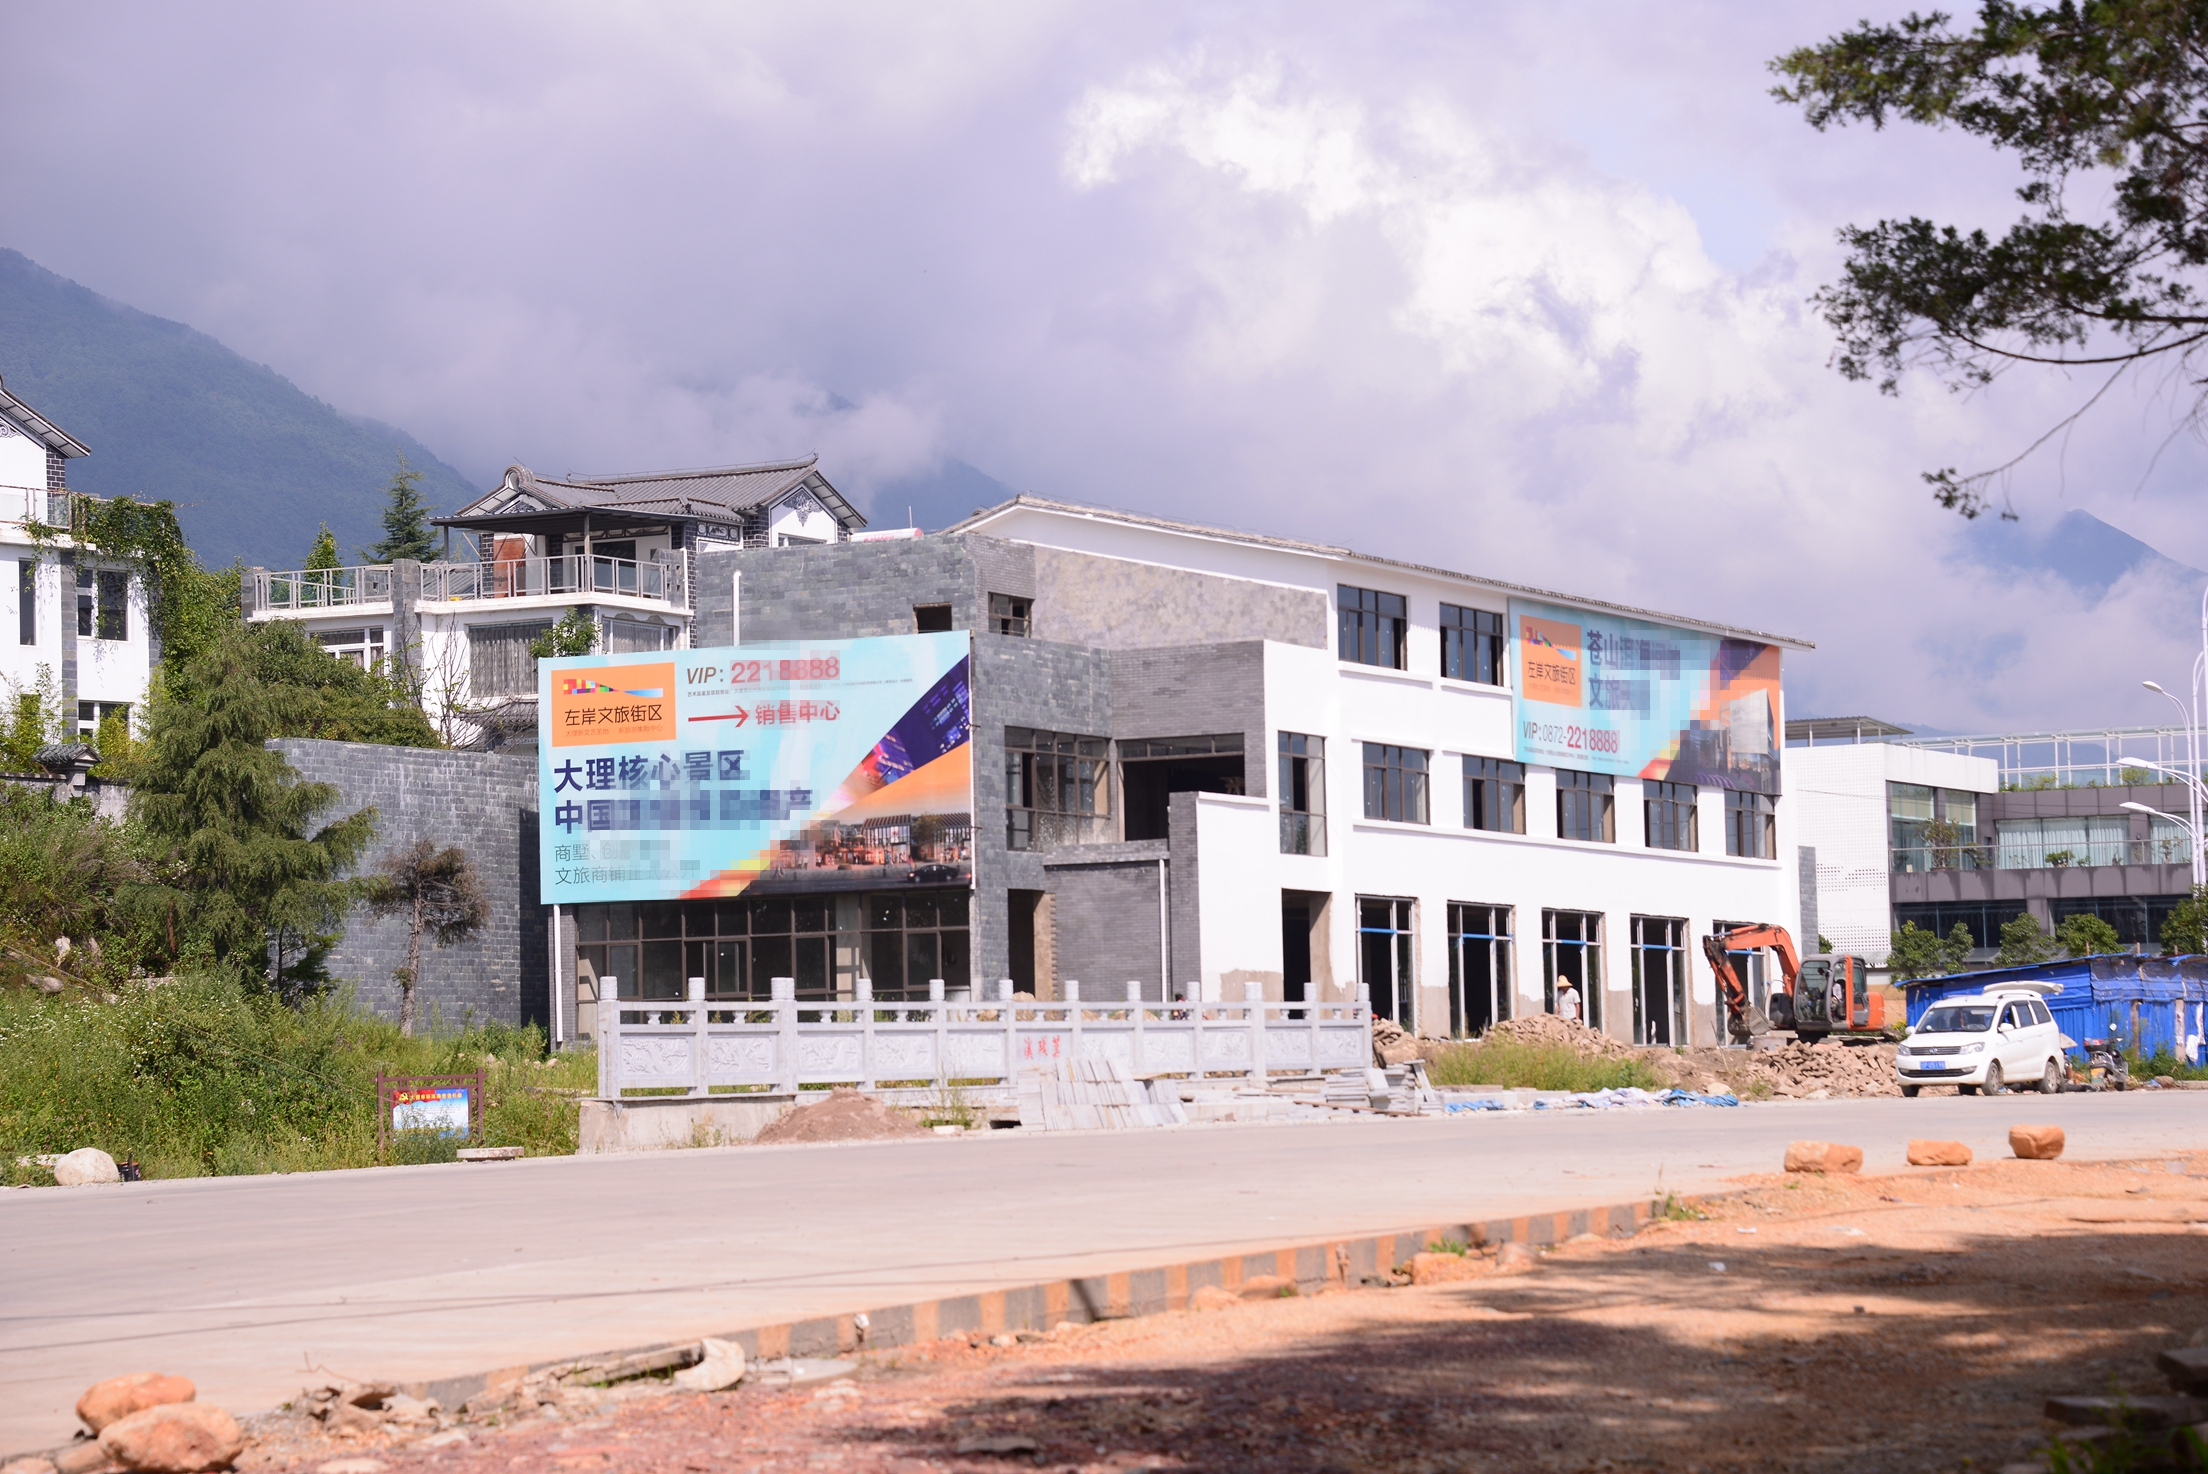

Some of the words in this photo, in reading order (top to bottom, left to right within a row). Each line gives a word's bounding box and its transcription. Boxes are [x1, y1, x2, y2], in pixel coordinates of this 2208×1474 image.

[1528, 660, 1576, 684] 左岸文旅街区
[564, 704, 662, 726] 左岸文旅街区
[755, 701, 840, 725] 销售中心
[554, 750, 745, 793] 大理核心景区
